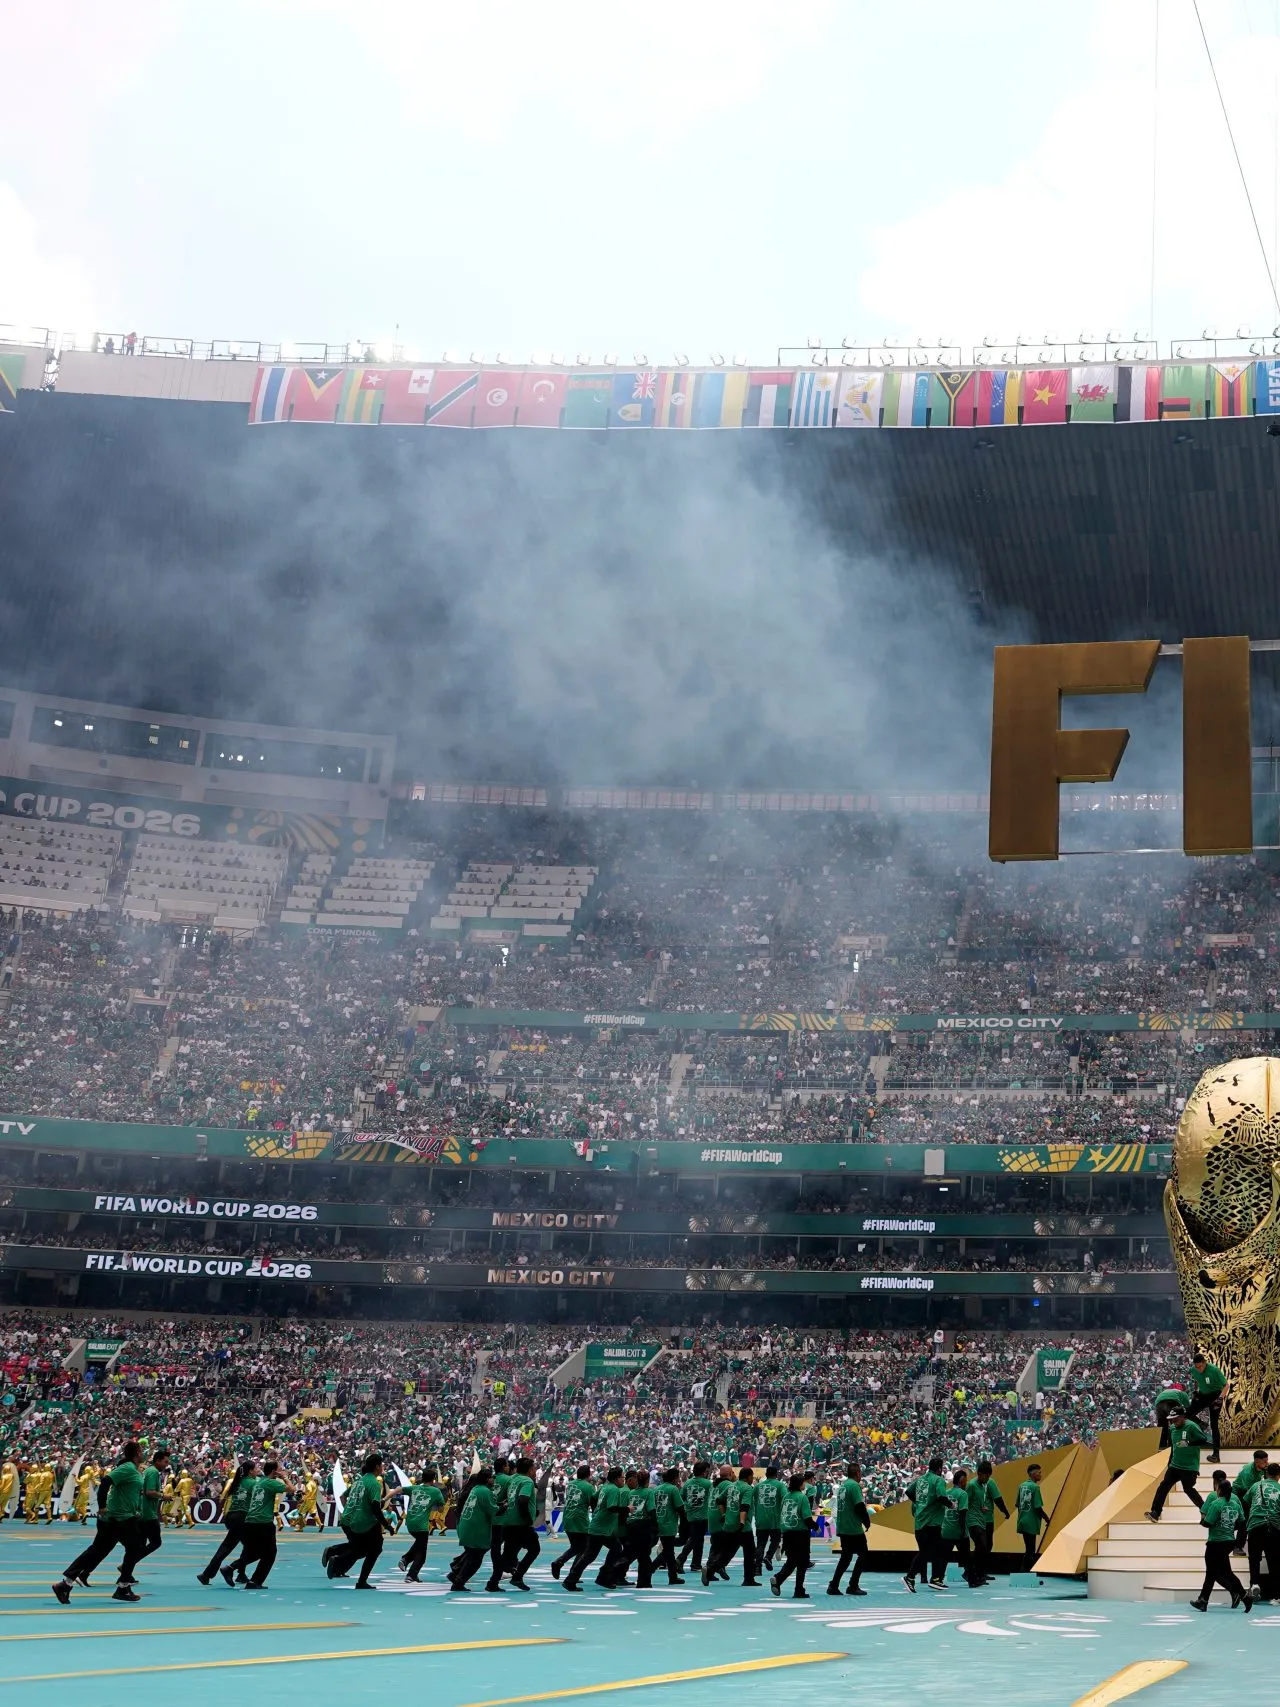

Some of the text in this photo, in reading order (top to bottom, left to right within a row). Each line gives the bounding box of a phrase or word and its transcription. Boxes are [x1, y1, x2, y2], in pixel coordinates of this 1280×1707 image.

[13, 792, 82, 819] CUP
[86, 801, 201, 836] 2026
[306, 927, 333, 936] COPA
[583, 1014, 646, 1026] #FIFAWorldCup
[937, 1017, 1064, 1029] MEXICO CITY
[700, 1149, 783, 1165] #FIFAWorldCup
[94, 1195, 318, 1220] FIFA WORLD CUP 2026
[492, 1211, 620, 1229] MEXICO CITY
[862, 1219, 936, 1233] #FIFAWorldCup
[131, 1257, 202, 1275] WORLD
[204, 1259, 244, 1276] CUP
[487, 1269, 615, 1286] MEXICO CITY
[860, 1277, 934, 1292] #FIFAWorldCup
[603, 1348, 647, 1358] SALIDA EXIT 3
[1043, 1359, 1066, 1369] SALIDA
[1045, 1368, 1059, 1377] EXIT
